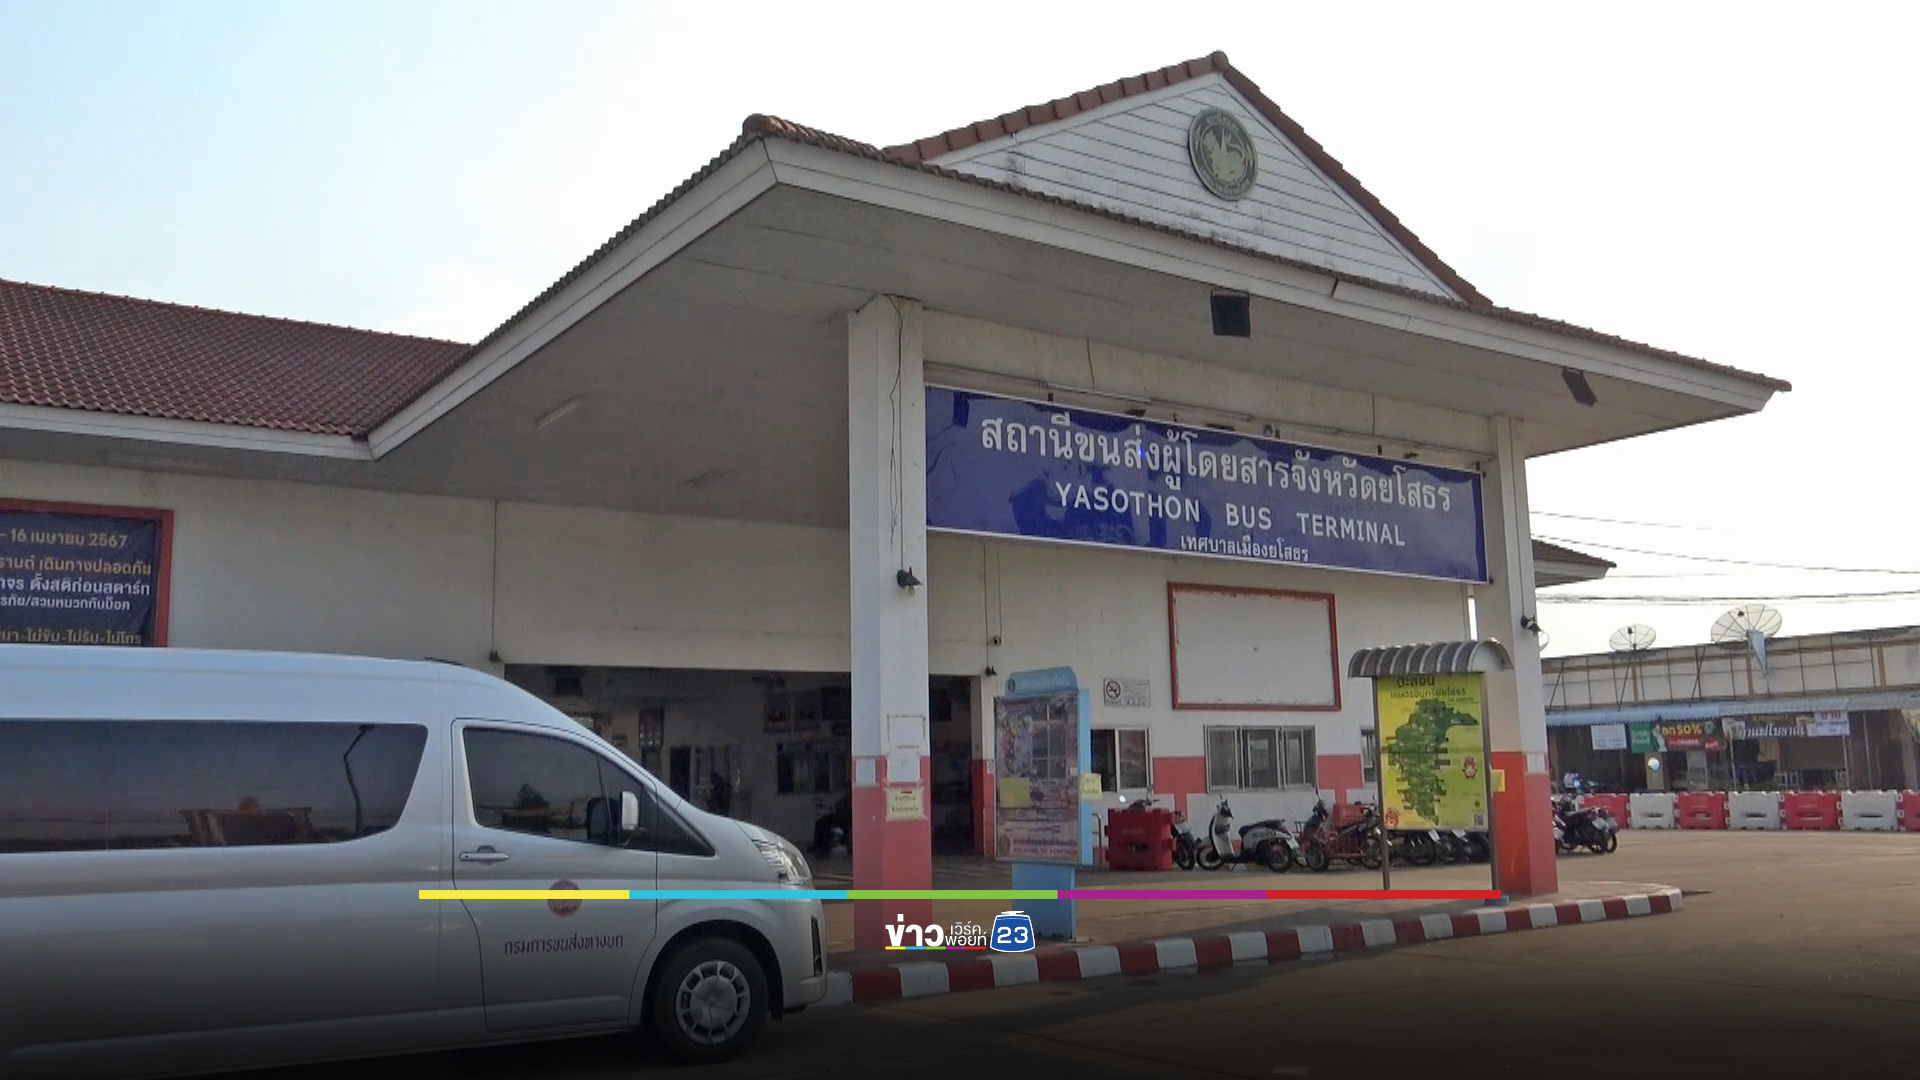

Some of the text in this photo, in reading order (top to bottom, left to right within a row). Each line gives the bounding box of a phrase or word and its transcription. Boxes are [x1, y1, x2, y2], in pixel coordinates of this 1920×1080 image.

[981, 412, 1451, 511] สถานีขนส่งผู้โดยสารจังหวัดยโสธร
[1055, 481, 1405, 547] YASOTHON BUS TERMINAL
[10, 528, 27, 543] 16
[31, 532, 85, 546] เมษายน
[88, 532, 129, 549] 2567
[1180, 534, 1309, 562] เทศบาลเมืองยโสธร
[39, 556, 152, 576] เดินทางปลอดภัย
[504, 933, 624, 955] กรมการขนส่งทางบก
